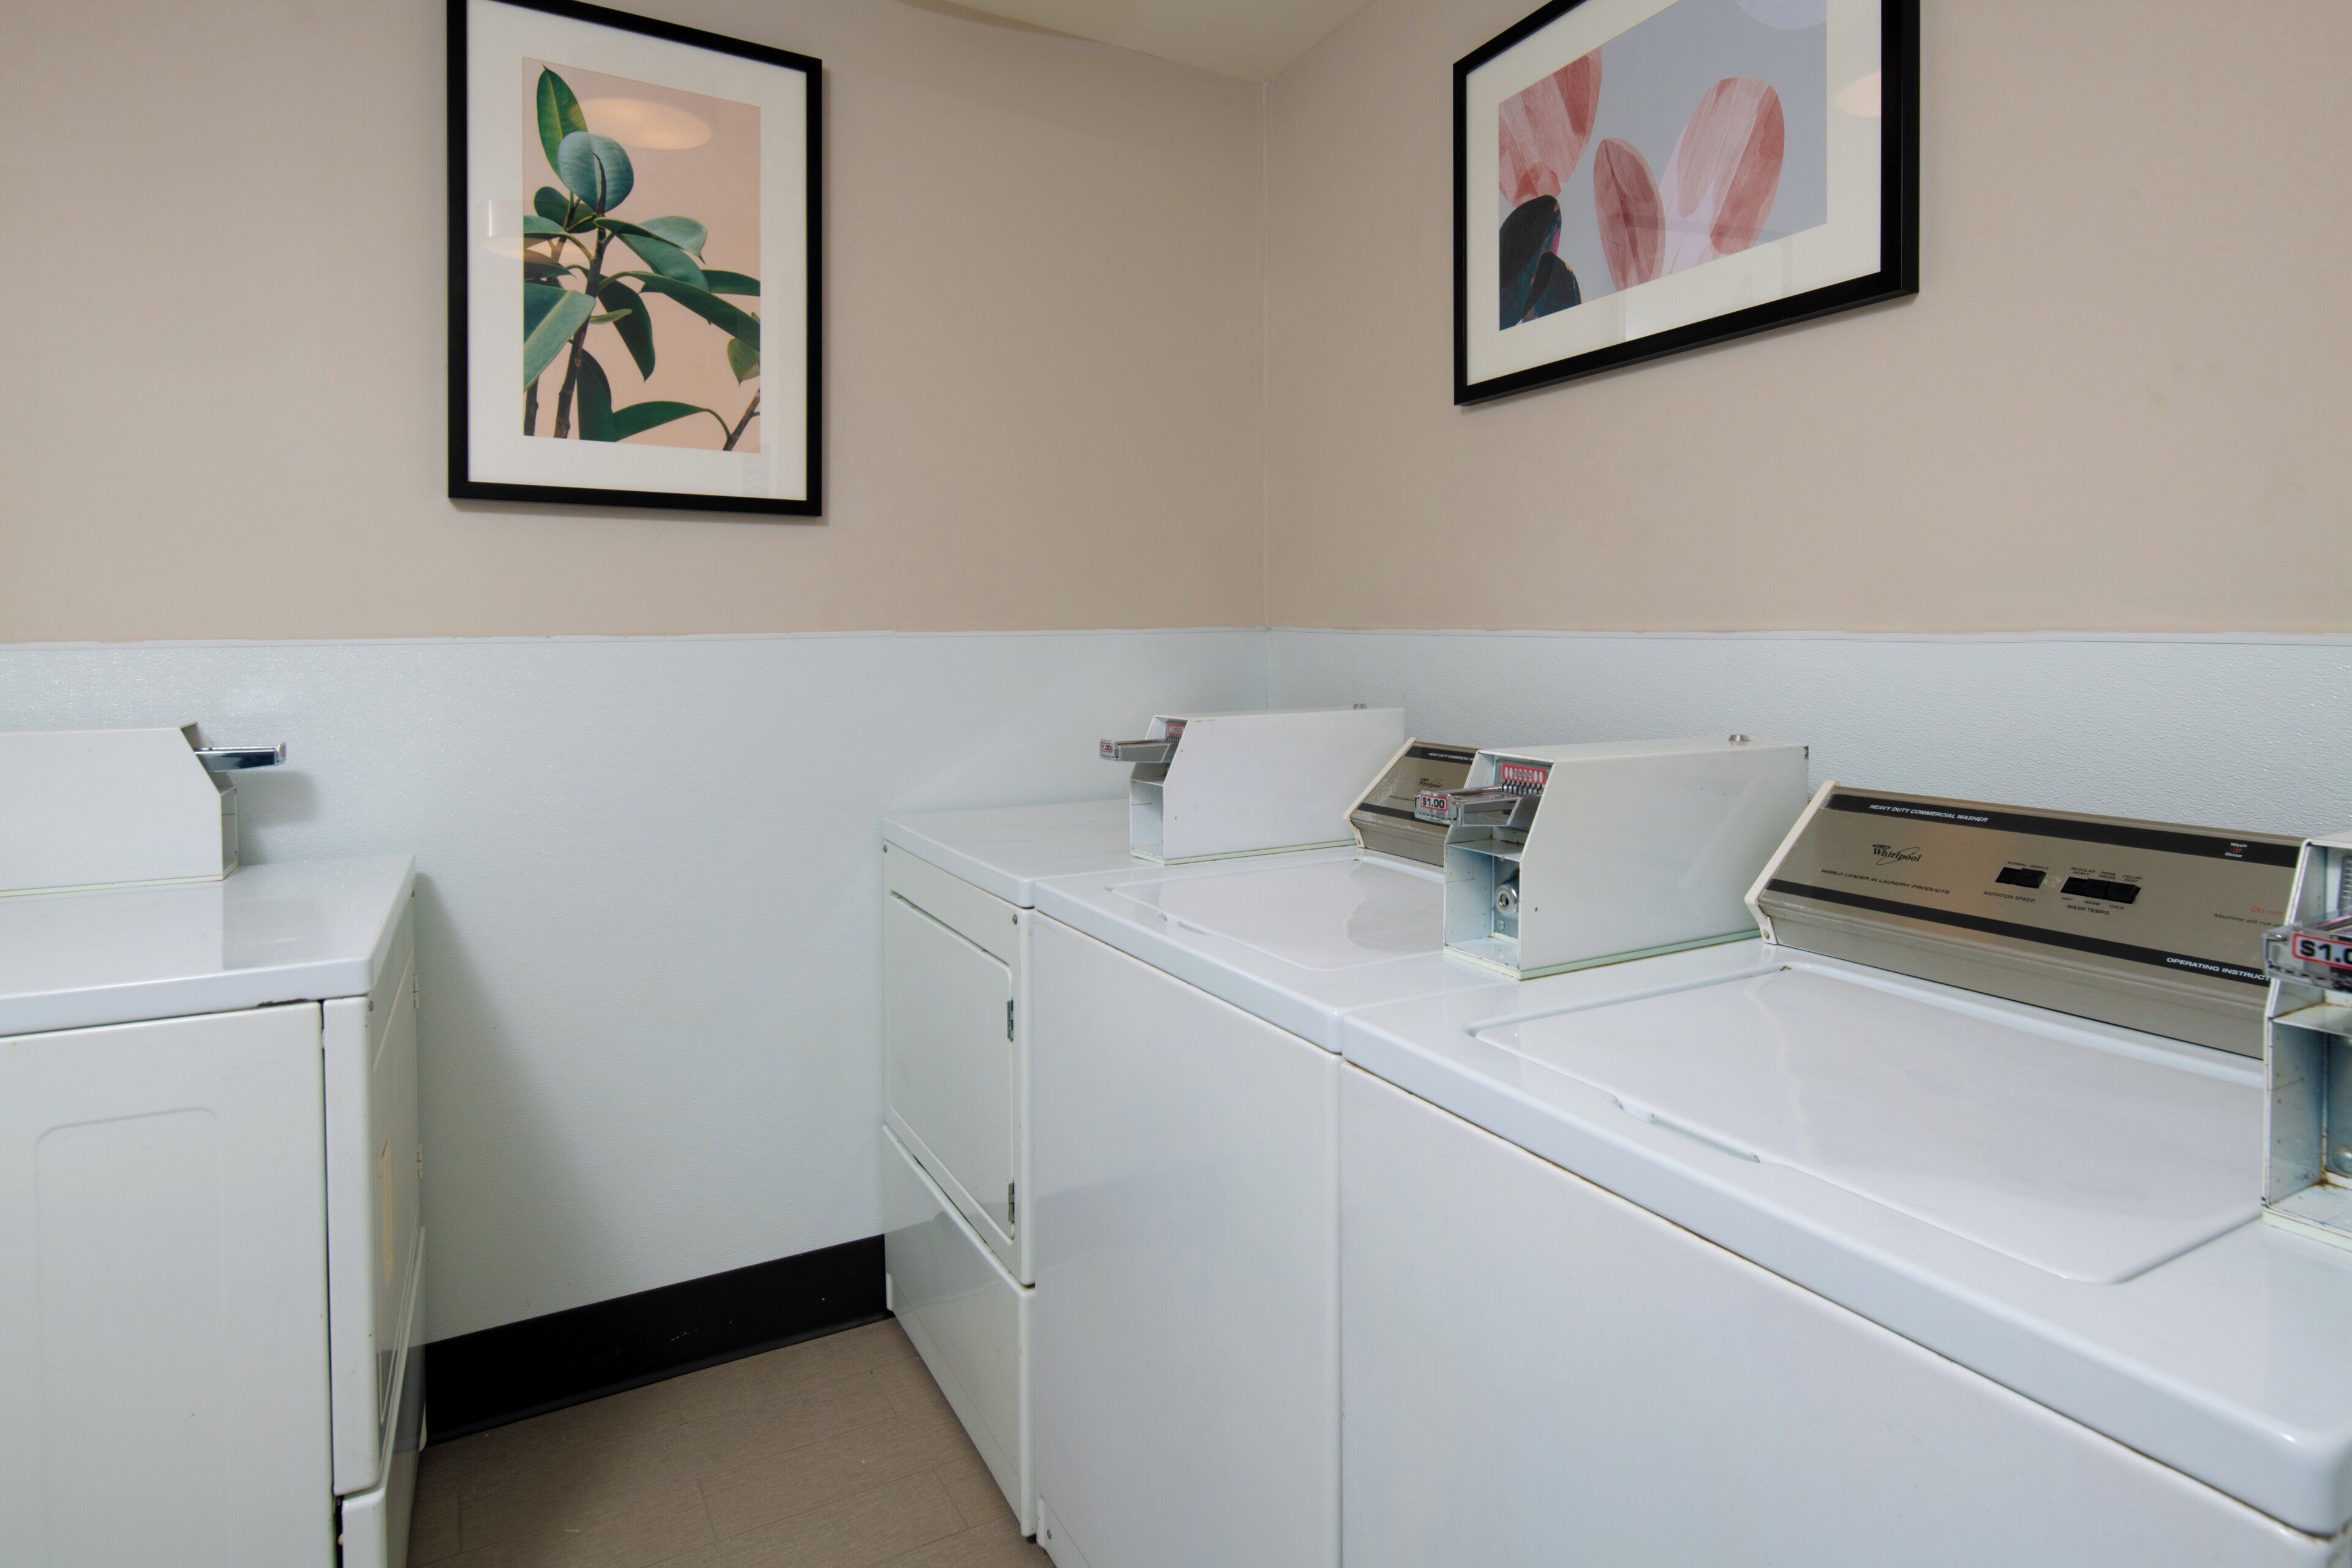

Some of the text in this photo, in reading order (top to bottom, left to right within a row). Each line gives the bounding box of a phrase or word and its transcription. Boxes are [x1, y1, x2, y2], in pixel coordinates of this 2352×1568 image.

[1422, 797, 1445, 809] $1.00
[1910, 809, 1956, 818] COMMERCIAL
[1873, 848, 1922, 862] Whirlpool
[1879, 879, 1911, 888] LAUNDRY
[1912, 884, 1951, 894] PRODUCTS
[1983, 891, 2014, 899] AGITATION
[2214, 913, 2244, 922] Machine
[2166, 957, 2220, 971] OPERATING
